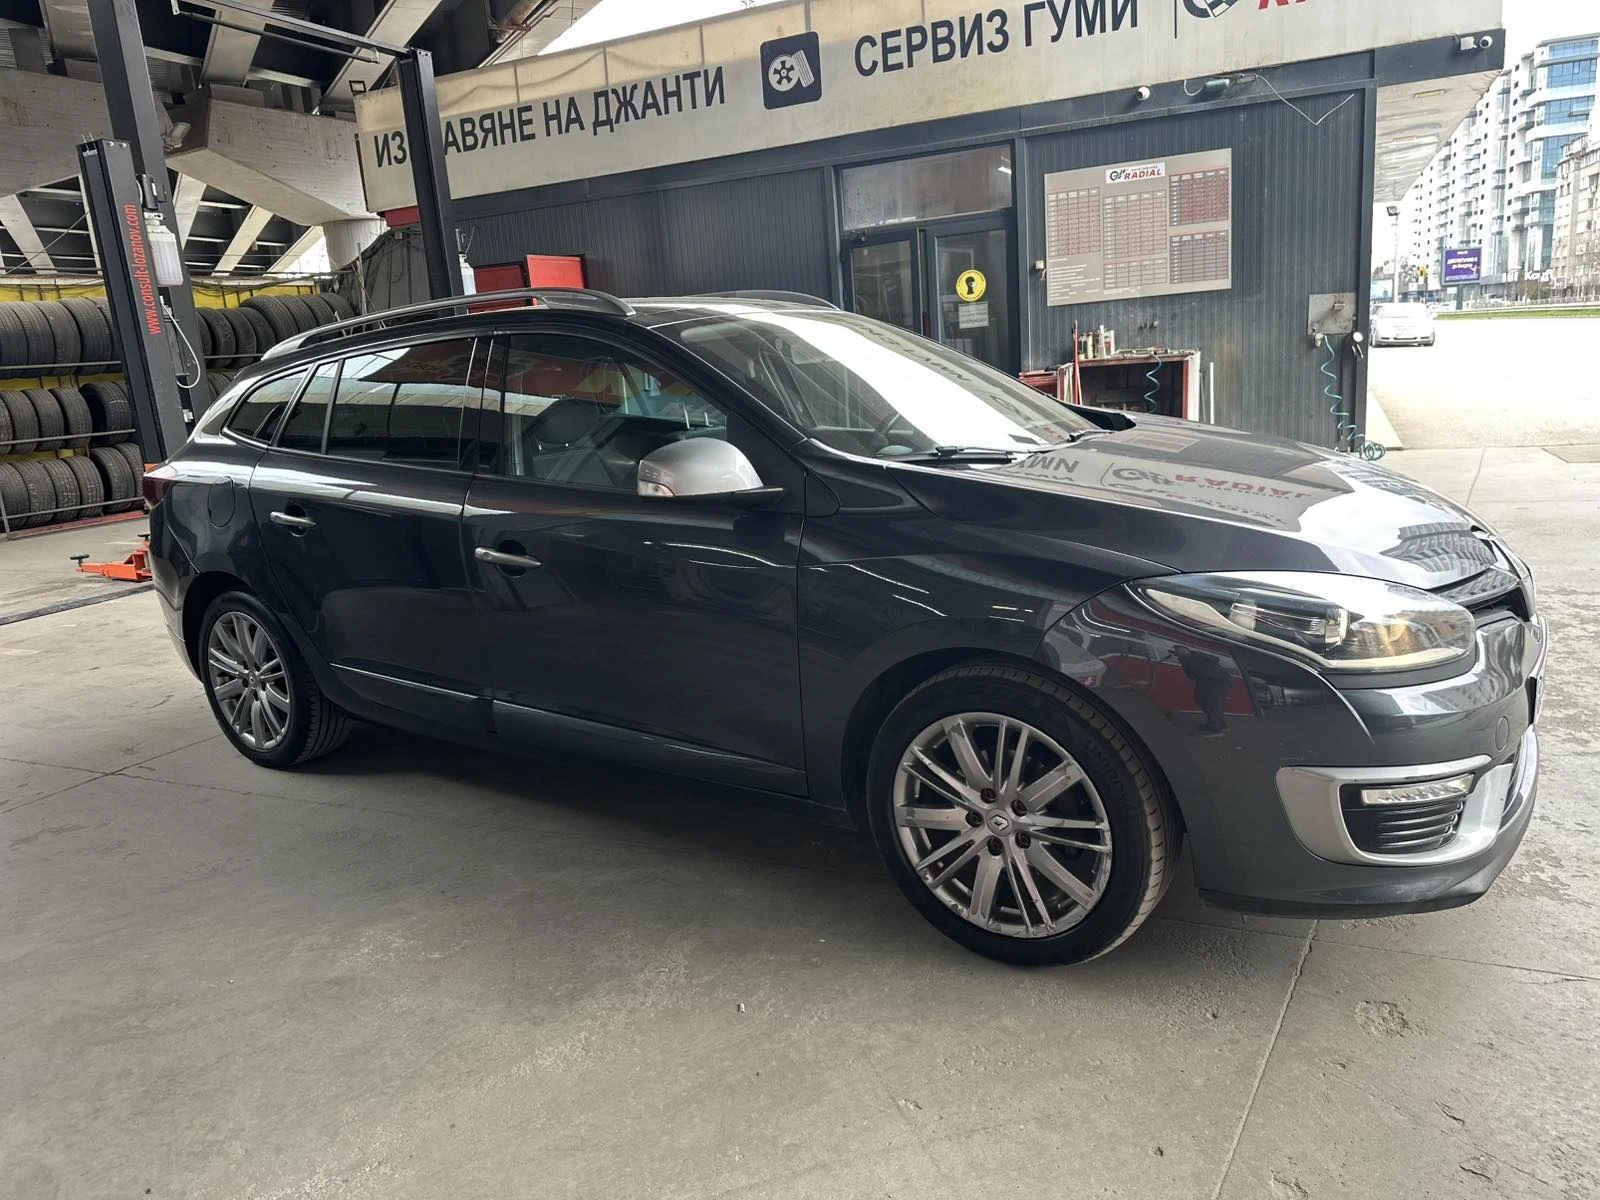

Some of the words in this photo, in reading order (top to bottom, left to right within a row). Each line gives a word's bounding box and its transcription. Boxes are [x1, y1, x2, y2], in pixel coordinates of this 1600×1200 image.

[853, 8, 1009, 77] СЕРВИЗ
[1023, 0, 1138, 48] ГУМИ
[374, 105, 536, 168] ИЗАВЯНЕ
[543, 97, 585, 137] НА
[592, 66, 726, 136] ДЖАНТИ
[1124, 169, 1162, 180] RADIAL
[123, 204, 160, 335] www.consult-lozanov.com
